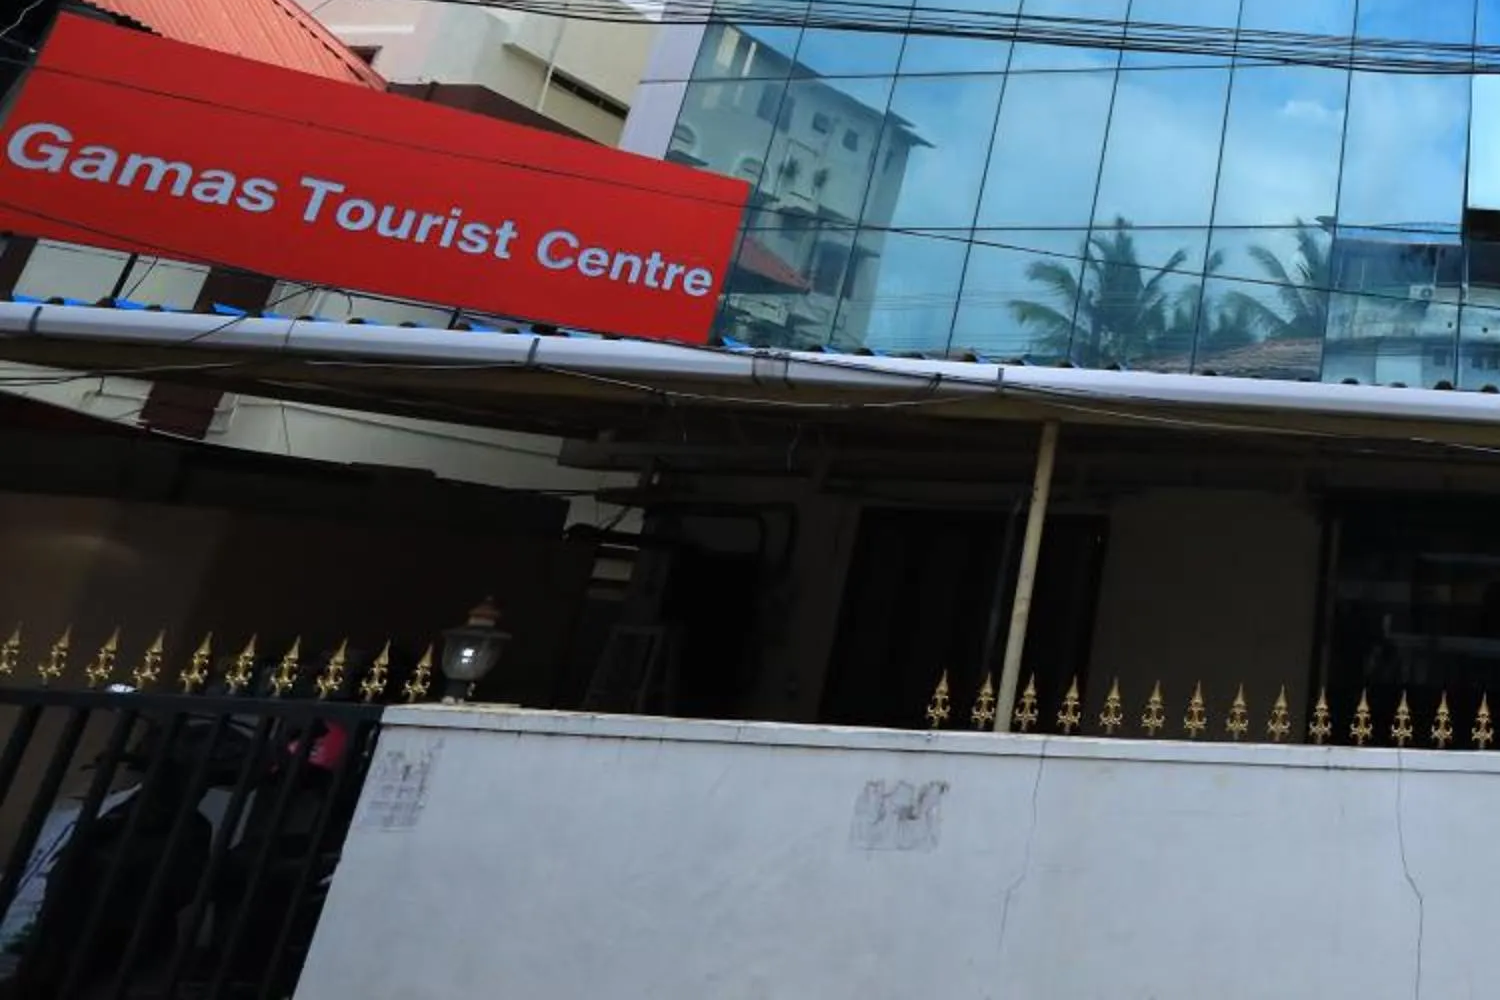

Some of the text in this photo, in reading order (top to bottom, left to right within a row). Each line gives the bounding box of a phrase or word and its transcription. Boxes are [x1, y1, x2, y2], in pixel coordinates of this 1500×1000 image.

[6, 121, 714, 297] Gamas Tourist Centre
